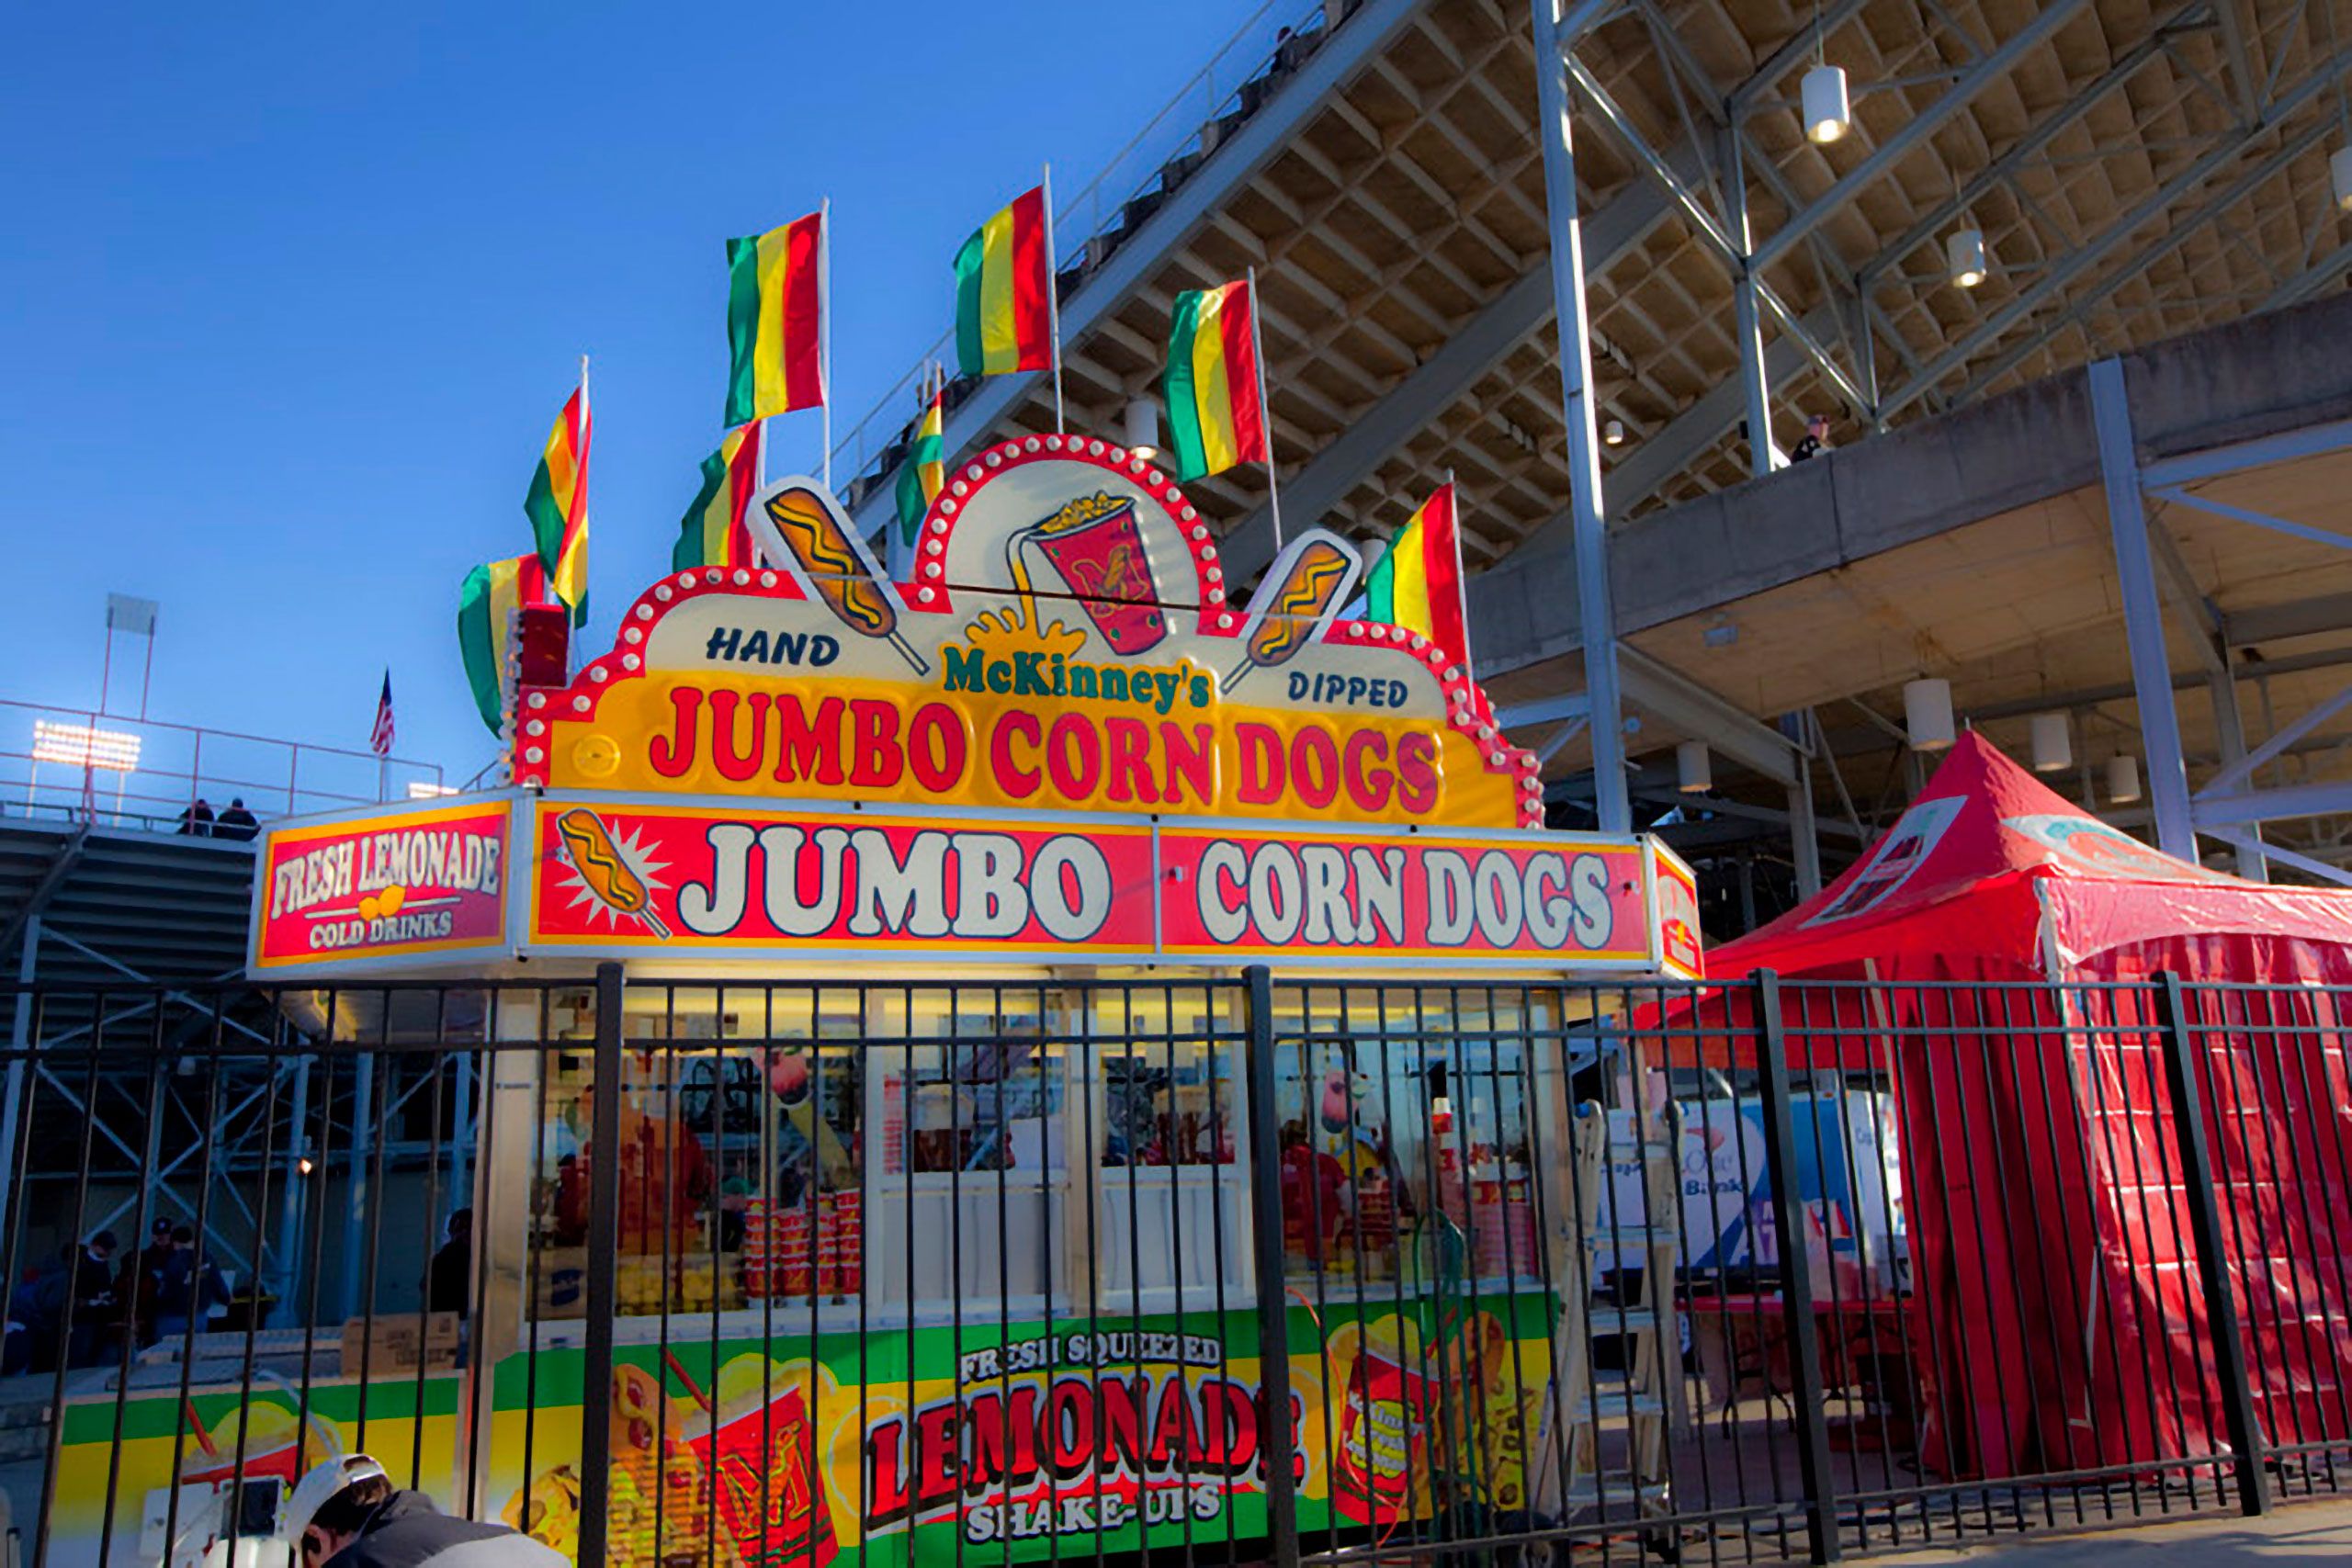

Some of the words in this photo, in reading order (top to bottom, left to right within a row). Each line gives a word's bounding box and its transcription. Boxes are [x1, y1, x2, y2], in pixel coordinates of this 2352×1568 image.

[706, 626, 840, 668] HAND
[943, 646, 1210, 715] McKinney's
[1287, 671, 1408, 708] DIPPED
[650, 686, 966, 793] JUMBO
[990, 709, 1214, 807] CORN
[1235, 722, 1439, 815] DOGS
[271, 840, 356, 919] FRESH
[356, 829, 501, 896] LEMONADE
[677, 823, 1114, 942] JUMBO
[1197, 840, 1407, 946] CORN
[1422, 849, 1613, 950] DOGS
[309, 921, 365, 950] COLD
[368, 910, 452, 943] DRINKS
[960, 1336, 1060, 1382] FRESH
[1068, 1332, 1221, 1367] SQUEEZED
[967, 1484, 1220, 1542] SHAKE-UPS
